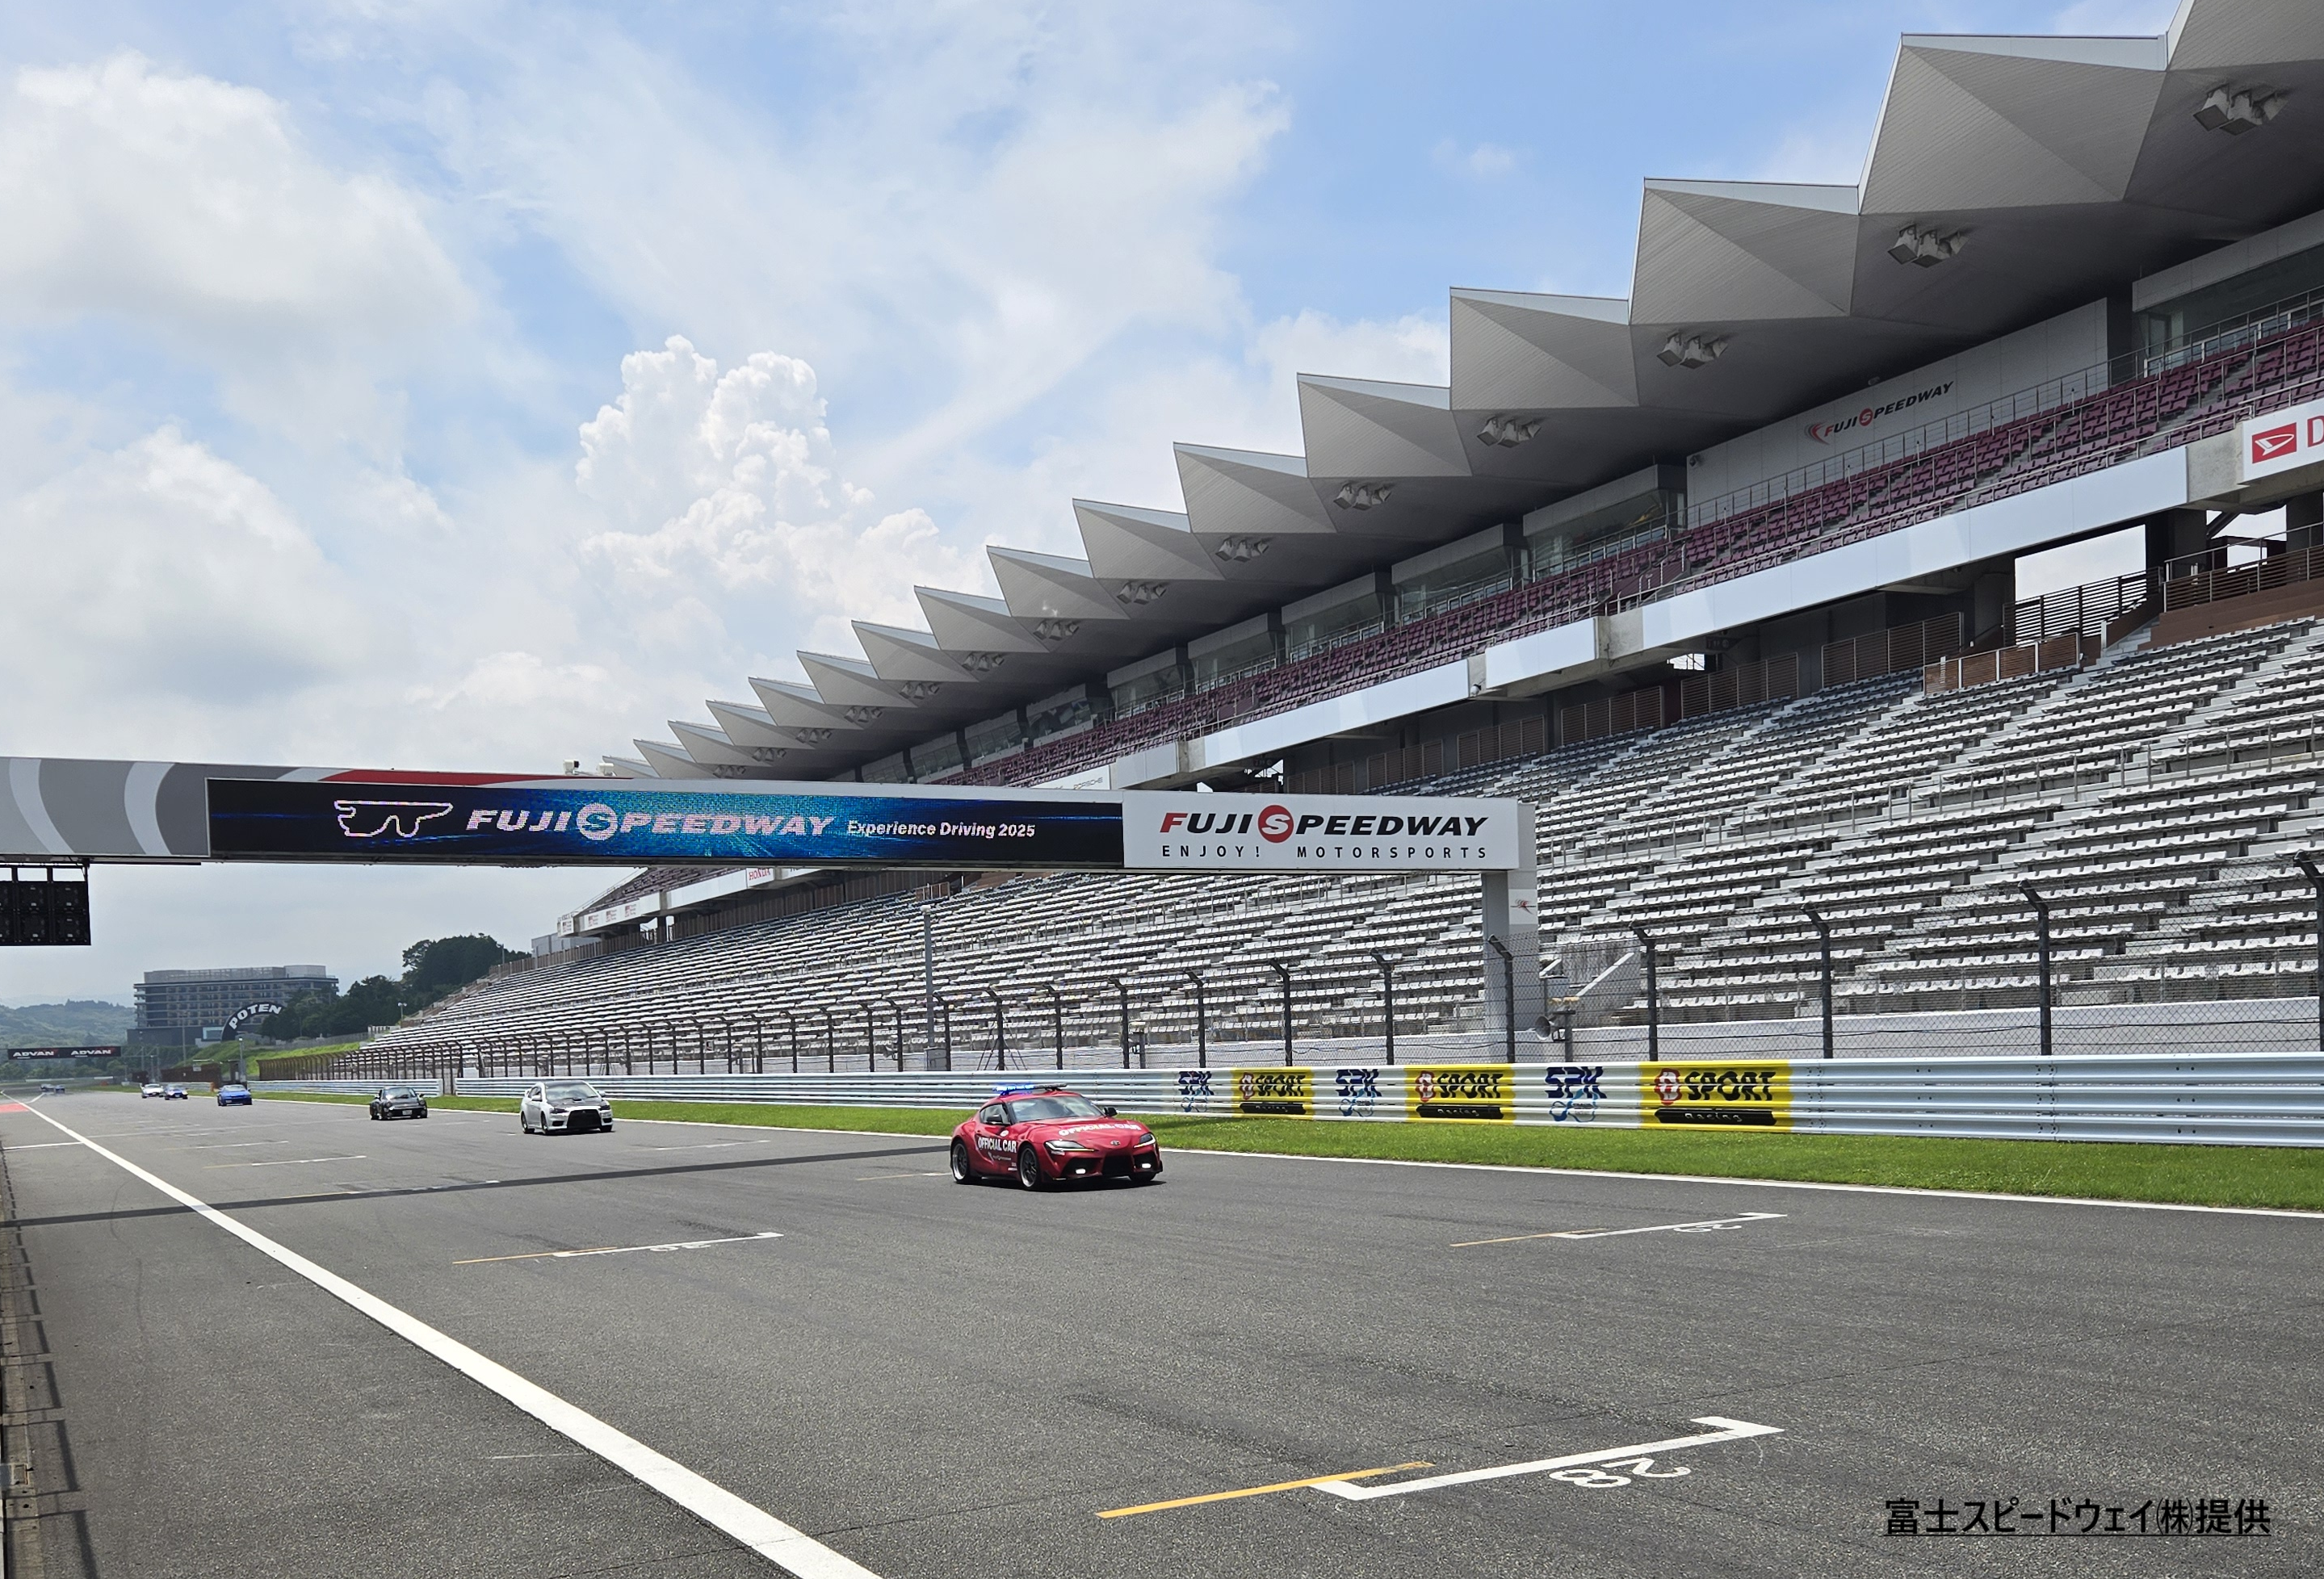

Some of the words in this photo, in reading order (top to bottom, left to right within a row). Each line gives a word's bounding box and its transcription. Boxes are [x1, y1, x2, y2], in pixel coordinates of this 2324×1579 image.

[1824, 417, 1858, 437] FUJI
[1859, 381, 1954, 426] SPEEDWAY
[466, 809, 573, 831] FUJI
[576, 802, 834, 840] SPEEDWAY
[848, 820, 936, 837] Experience
[940, 822, 996, 839] Driving
[998, 823, 1035, 837] 2025
[1160, 812, 1252, 833] FUJI
[1257, 804, 1488, 844] SPEEDWAY
[1162, 845, 1261, 858] ENJOY!
[1297, 845, 1487, 859] MOTORSPORTS
[1437, 1072, 1504, 1099] SPORT
[1544, 1066, 1608, 1099] SPK
[1684, 1070, 1777, 1101] SPORT
[978, 1137, 1002, 1151] OFFICIAL
[1003, 1139, 1017, 1154] CAR
[1549, 1457, 1692, 1488] 28
